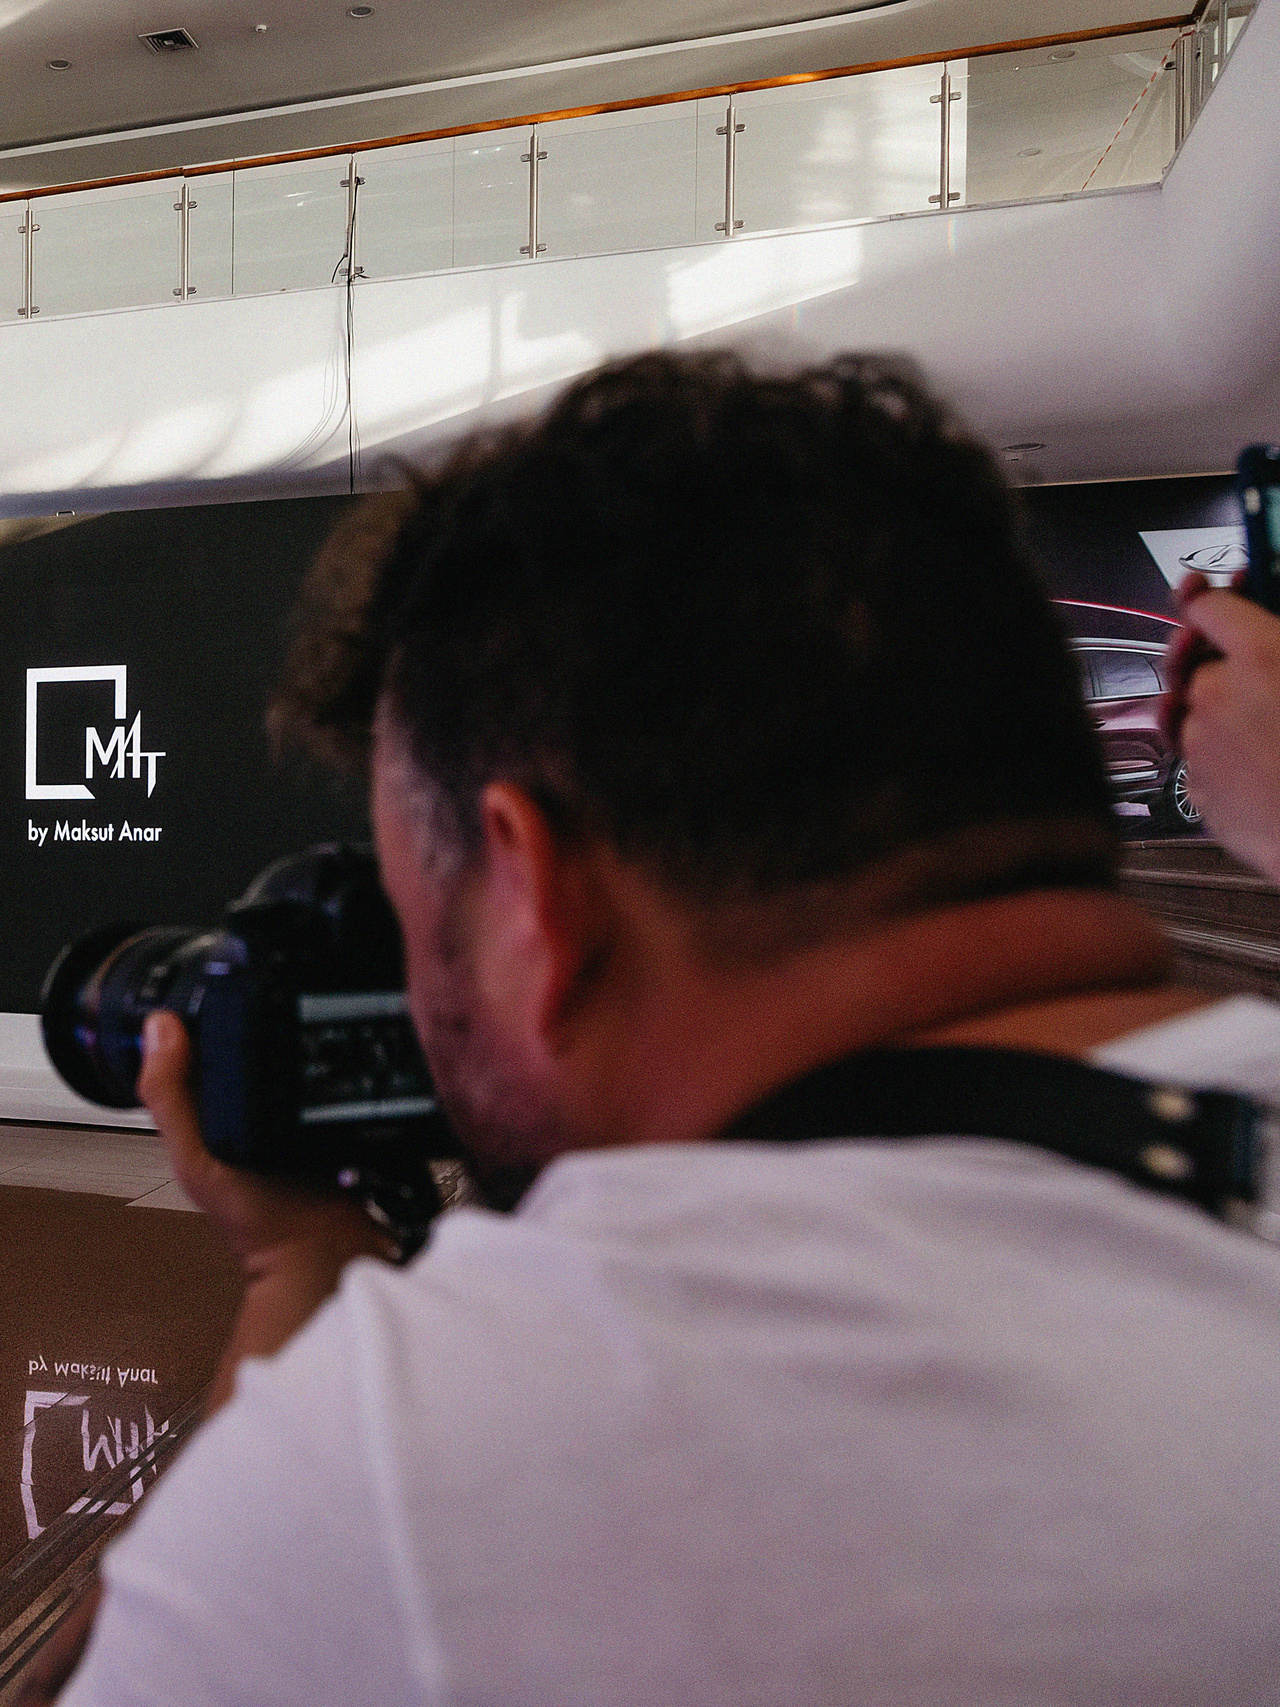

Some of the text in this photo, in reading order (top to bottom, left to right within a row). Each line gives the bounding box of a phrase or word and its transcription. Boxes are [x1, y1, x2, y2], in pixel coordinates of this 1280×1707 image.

[28, 819, 163, 847] by Maksut Anar
